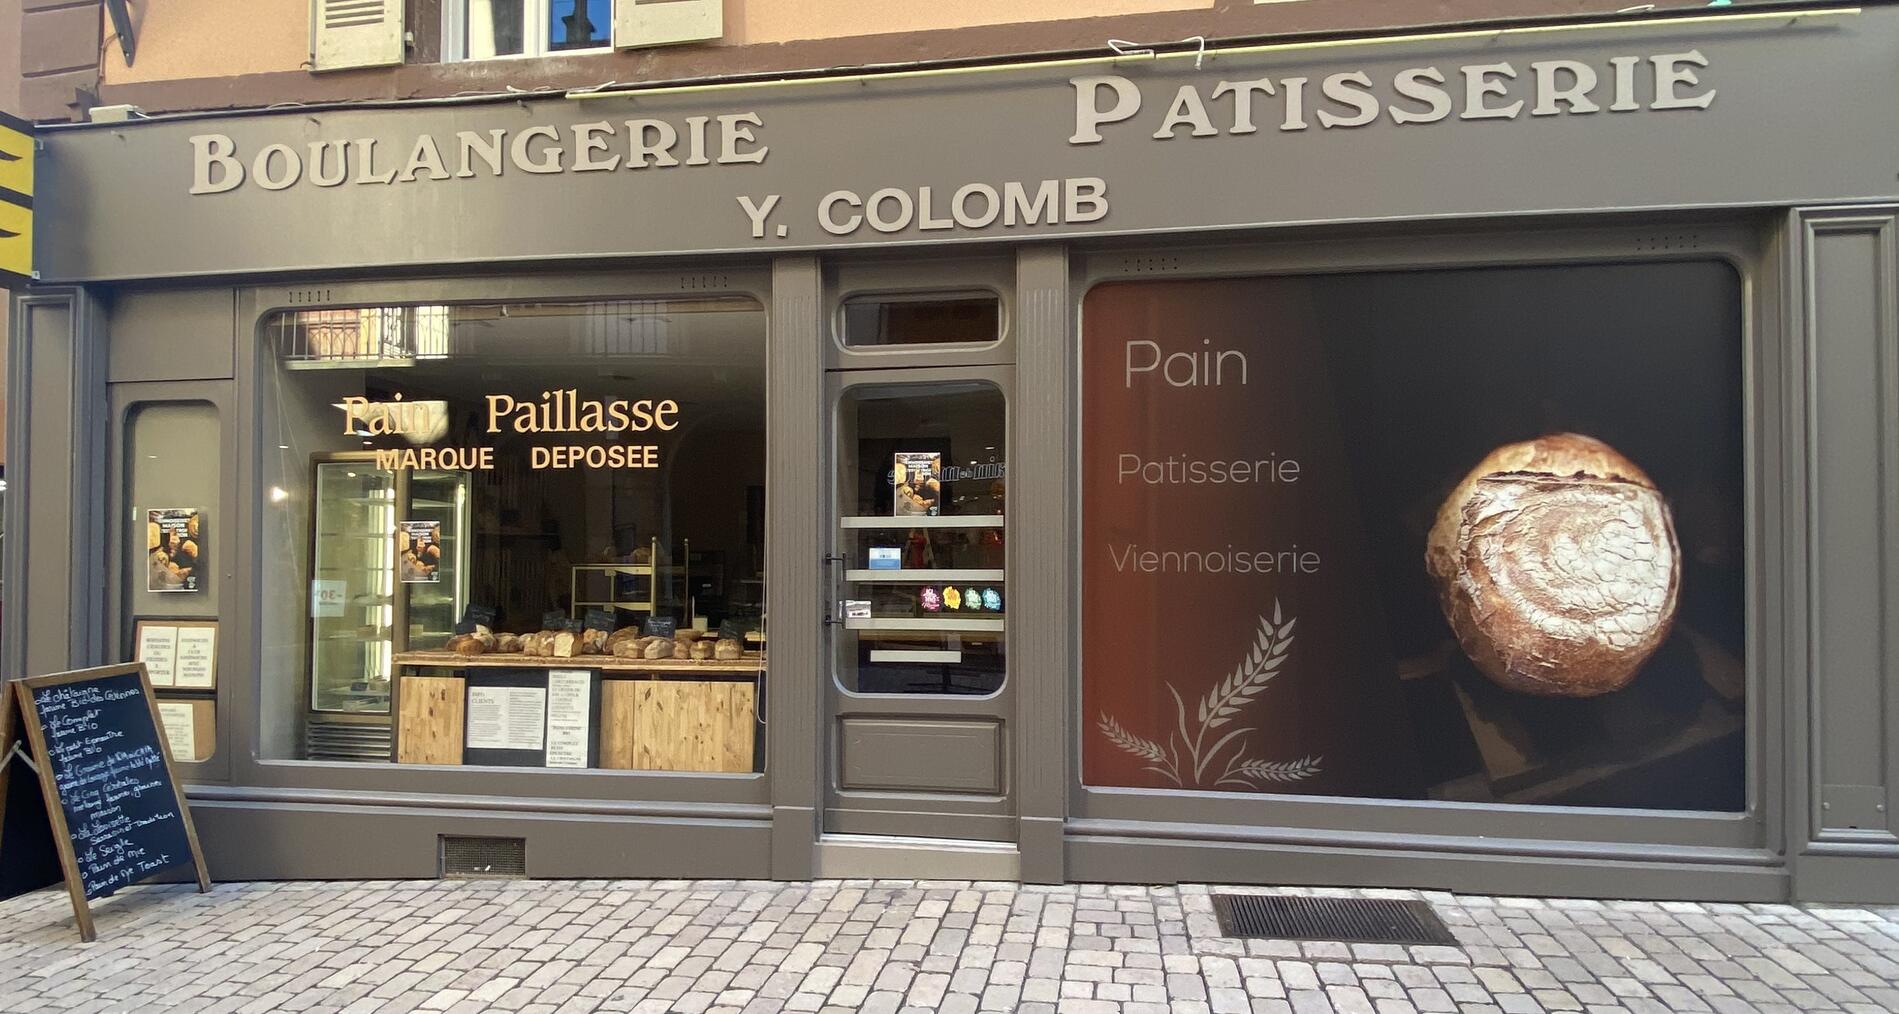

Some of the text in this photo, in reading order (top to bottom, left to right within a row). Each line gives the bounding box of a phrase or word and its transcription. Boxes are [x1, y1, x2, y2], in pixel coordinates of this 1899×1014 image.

[1069, 49, 1717, 145] PATISSERIE
[189, 111, 770, 195] BOULANGERIE
[737, 177, 1110, 239] Y. COLOMB
[1125, 338, 1248, 389] Pain
[342, 387, 679, 437] Pain Paillasse
[375, 445, 660, 471] MARQUE DEPOSEE
[1118, 451, 1301, 485] Patisserie
[1108, 543, 1321, 575] Viennoiserie
[137, 854, 169, 872] Toast
